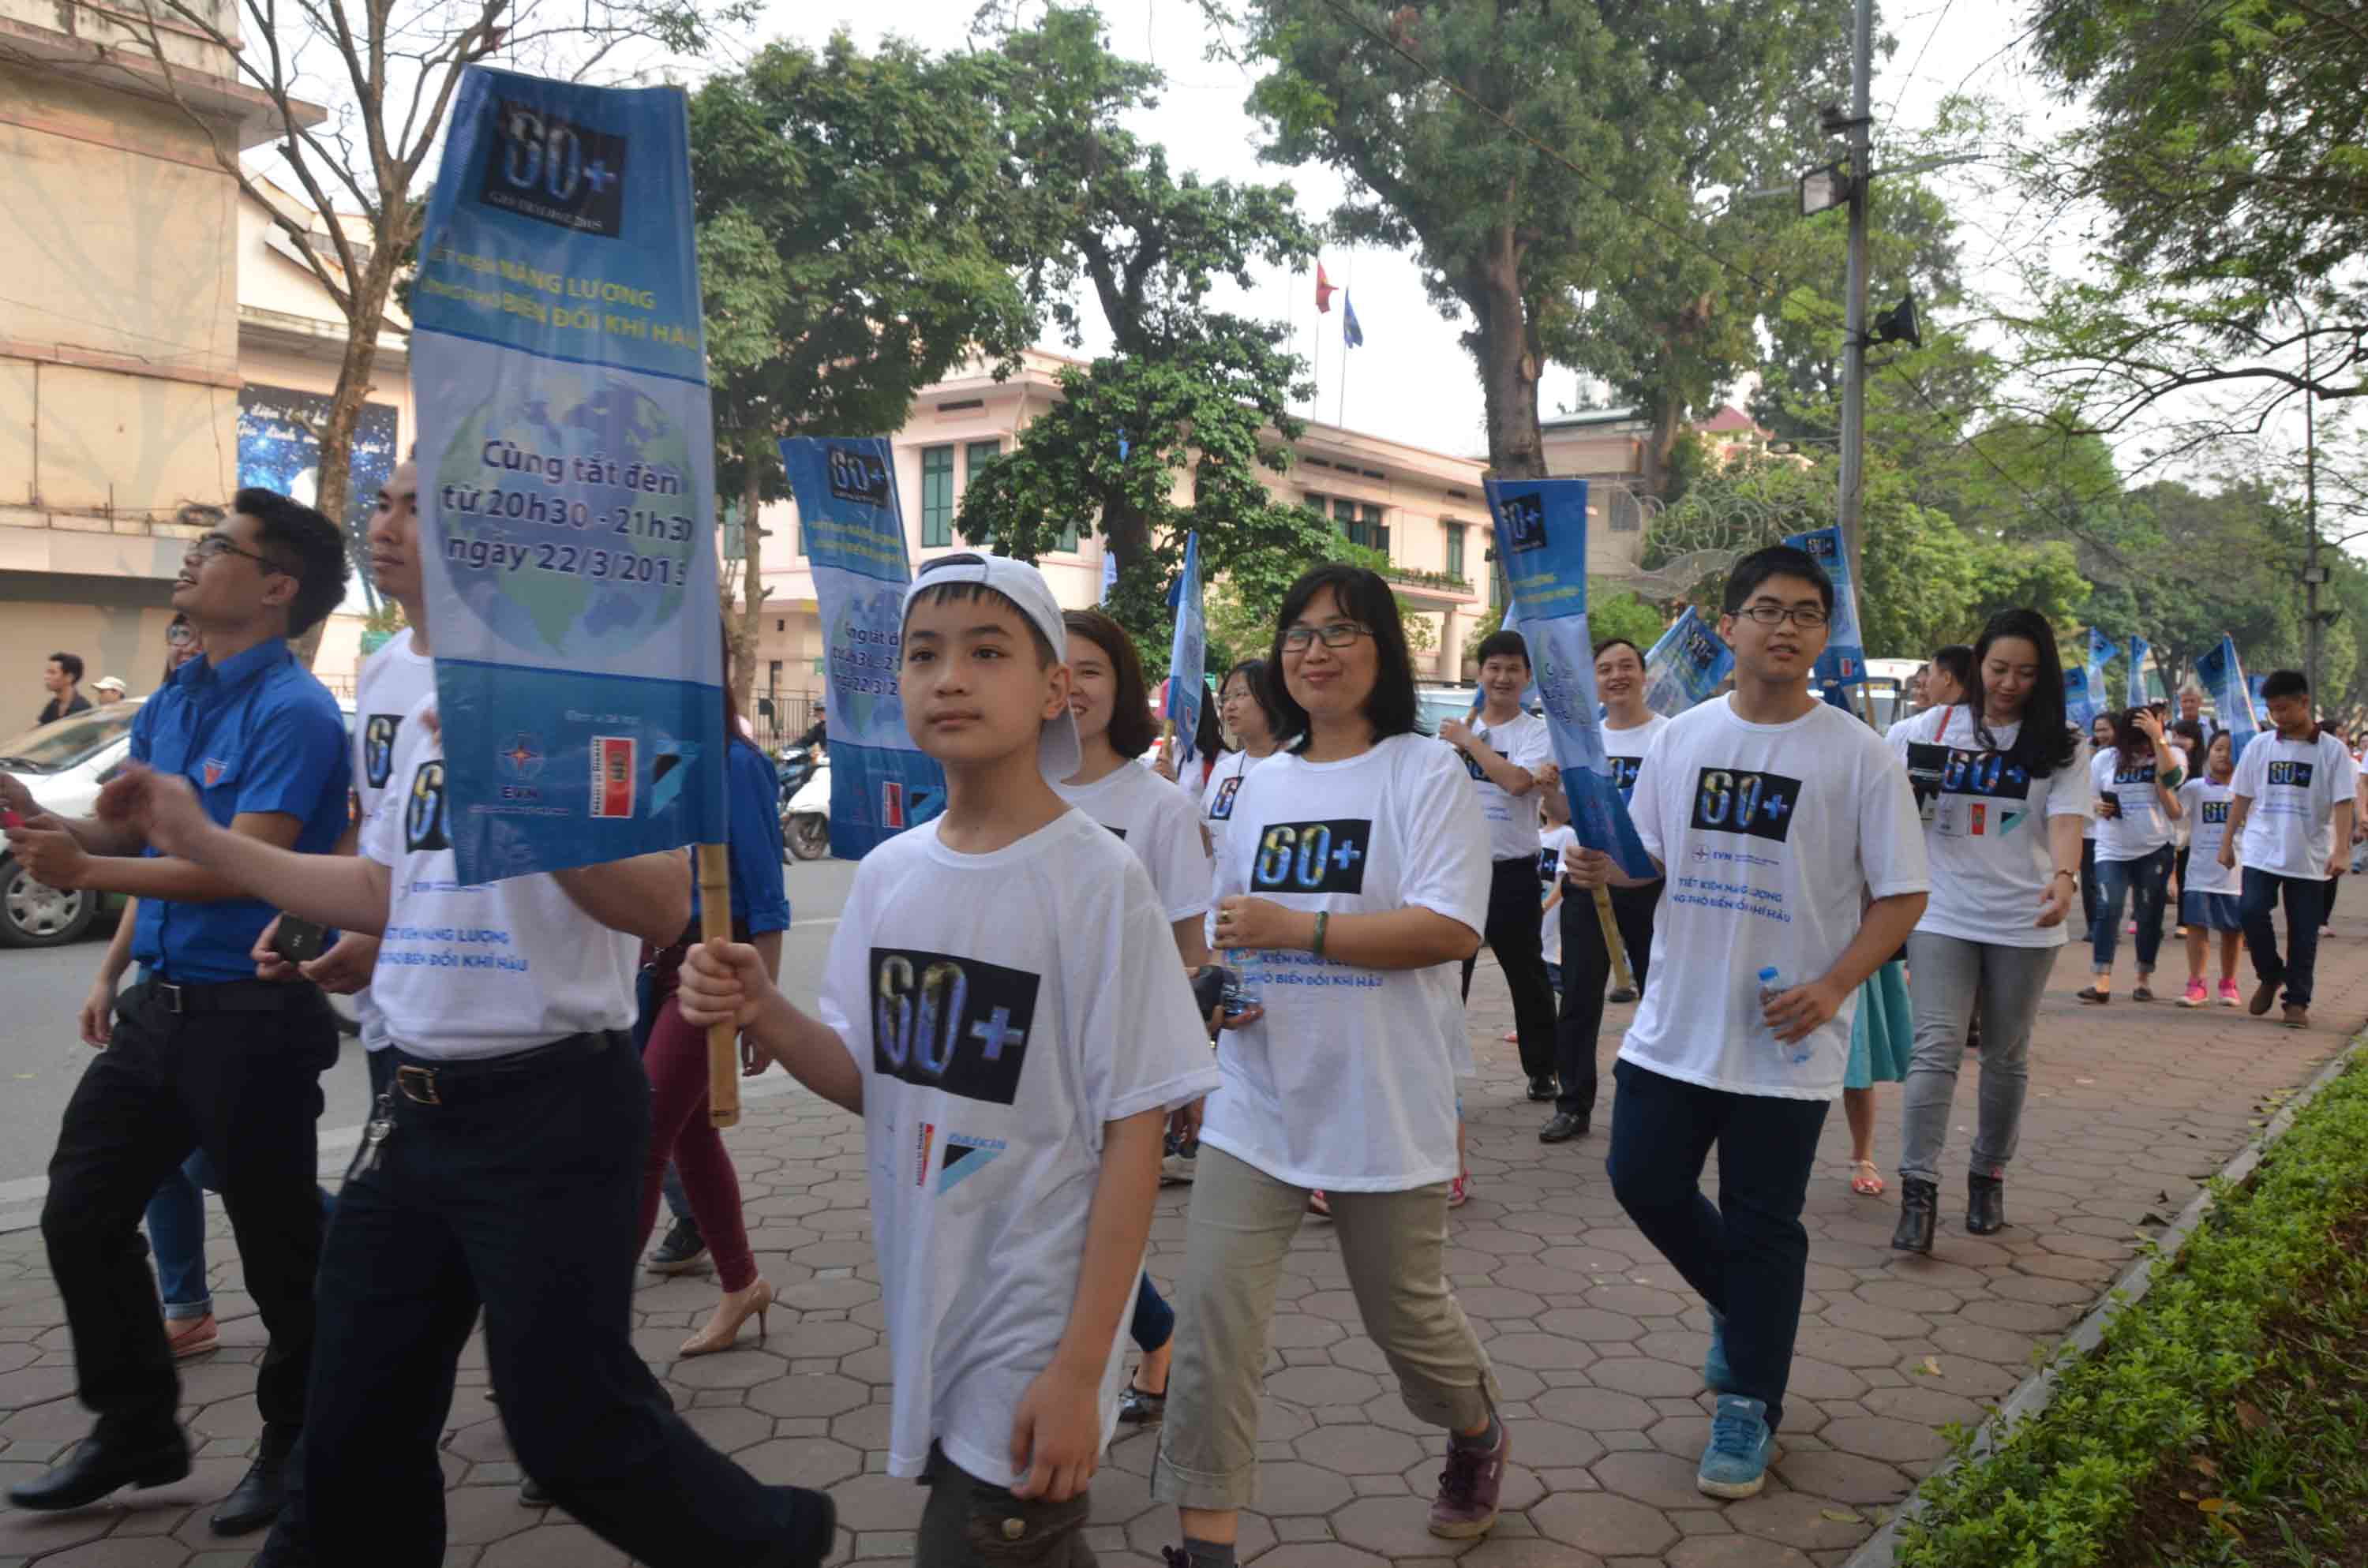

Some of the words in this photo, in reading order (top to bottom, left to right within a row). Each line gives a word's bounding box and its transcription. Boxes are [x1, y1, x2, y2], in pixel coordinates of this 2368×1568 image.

[507, 110, 618, 201] 60+
[482, 440, 564, 485] Cùng
[573, 455, 616, 487] tắt
[624, 462, 679, 496] đèn
[440, 484, 480, 513] từ
[485, 489, 590, 530] 20h30
[448, 530, 529, 571] ngày
[1701, 771, 1789, 827] 60+
[1256, 823, 1362, 889] 60+
[878, 953, 1025, 1075] 60+
